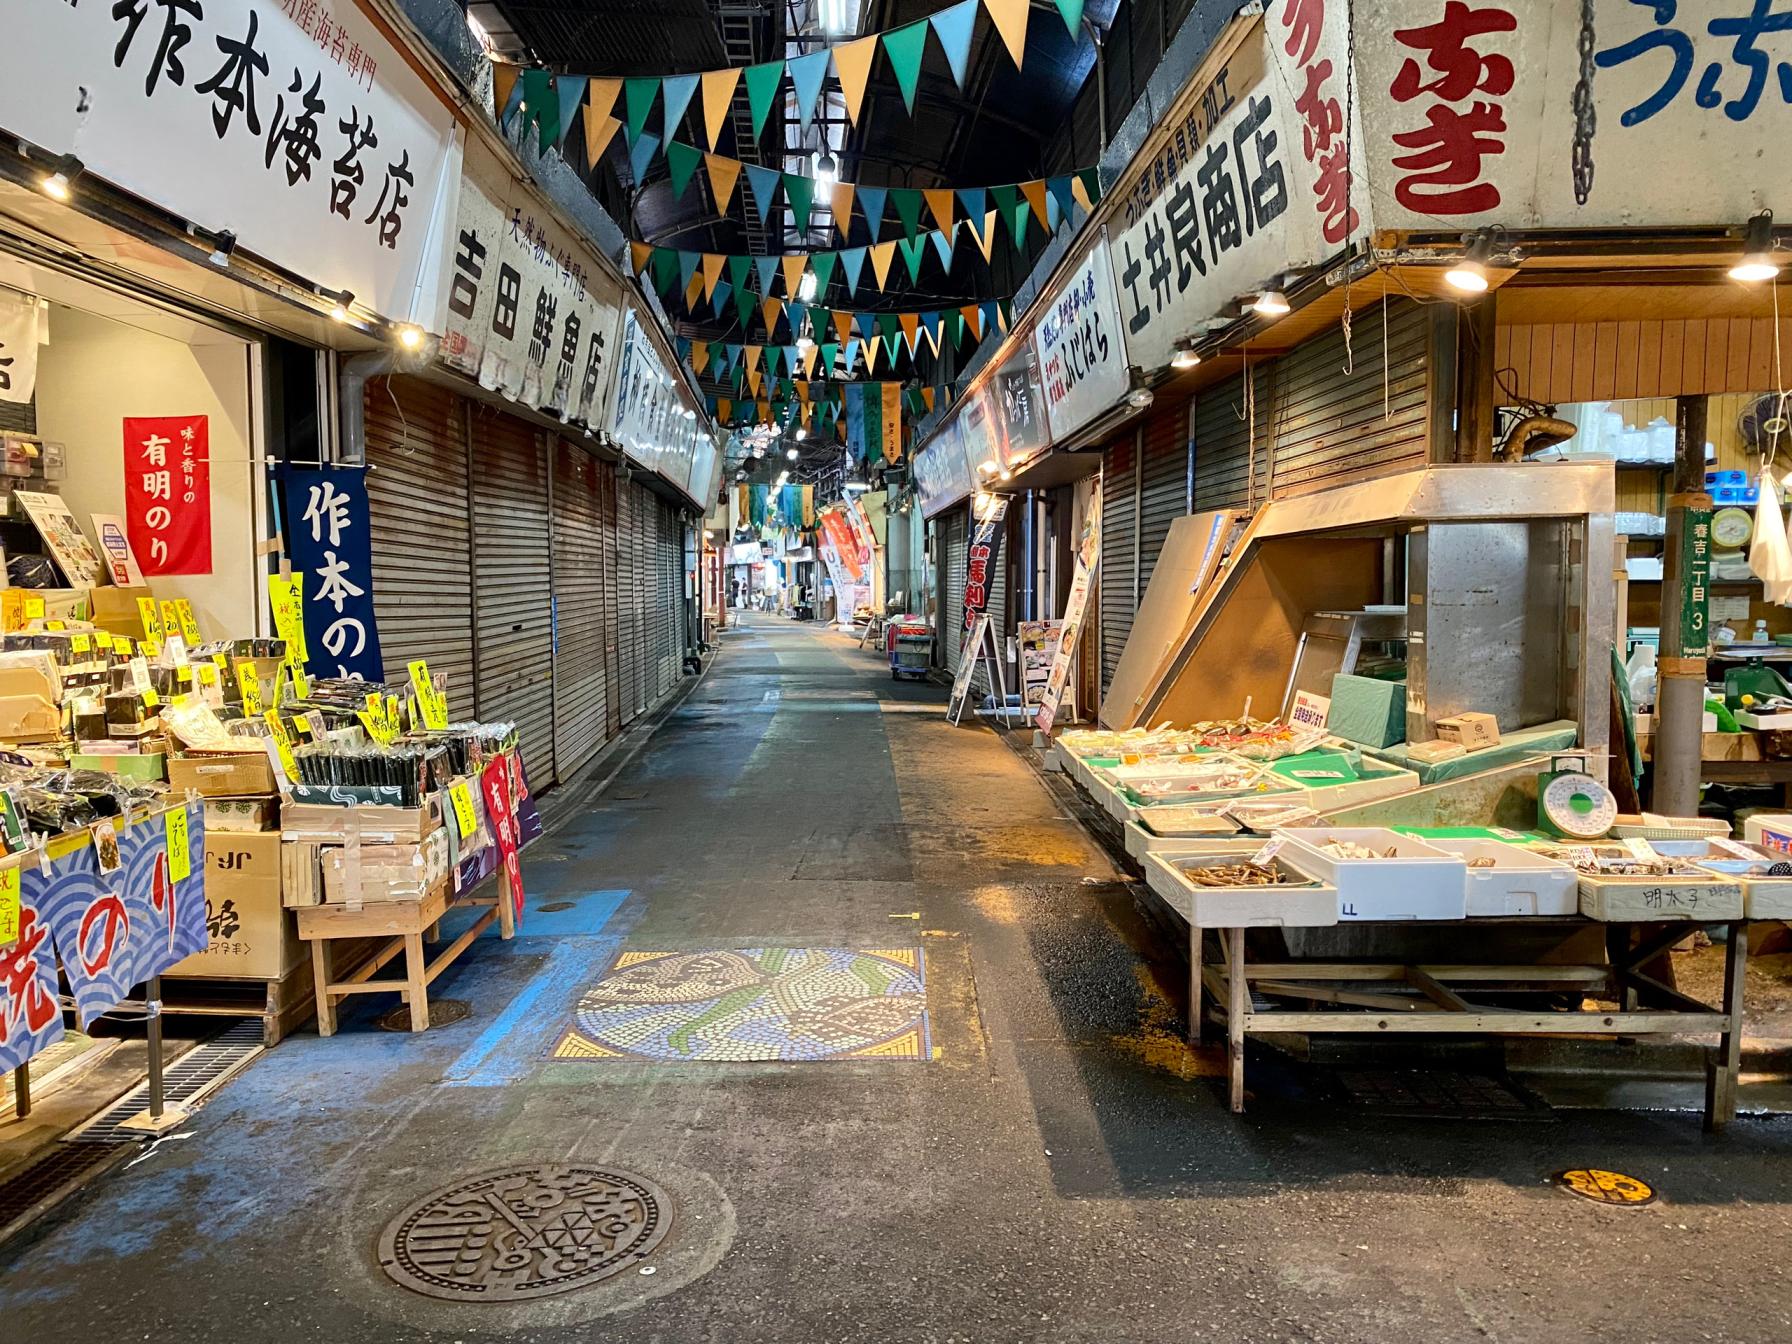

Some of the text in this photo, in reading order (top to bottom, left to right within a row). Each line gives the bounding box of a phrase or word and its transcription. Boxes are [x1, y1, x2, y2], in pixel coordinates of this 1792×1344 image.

[112, 0, 414, 250] 作本海苔店
[1122, 95, 1289, 335] 土井良商店
[449, 229, 604, 402] 吉田鮮魚店
[1061, 310, 1109, 392] ふじはら
[141, 434, 172, 568] 有明のり
[180, 426, 196, 504] 味と香りの
[1691, 523, 1708, 631] 春吉一丁目 3
[1342, 904, 1358, 916] LL
[1642, 887, 1699, 910] 明太子
